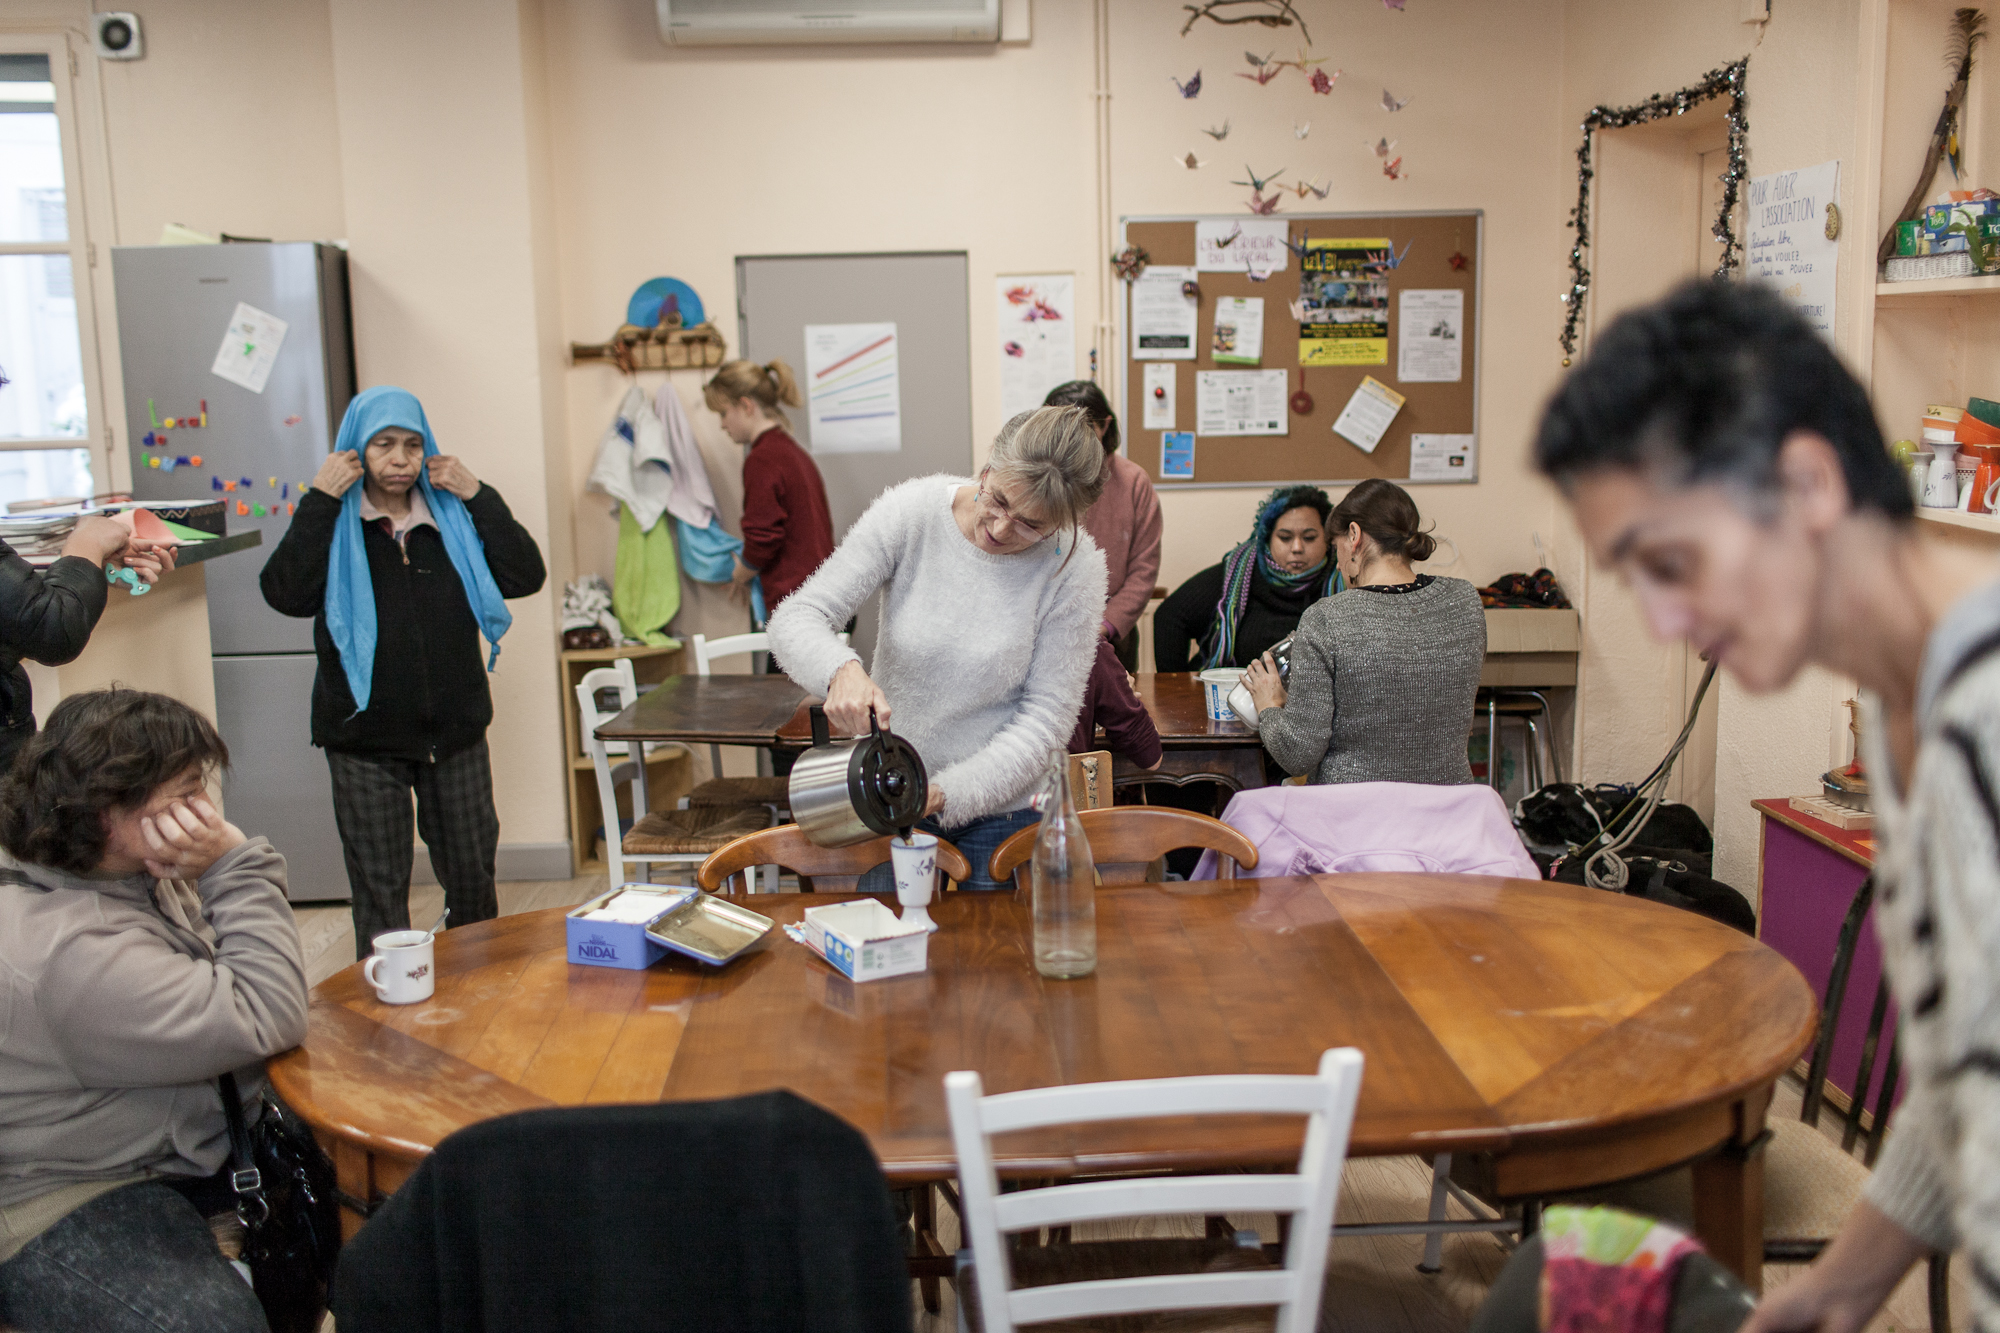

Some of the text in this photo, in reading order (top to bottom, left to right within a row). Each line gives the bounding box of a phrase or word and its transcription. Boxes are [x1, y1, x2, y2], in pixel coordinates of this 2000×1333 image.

[1751, 172, 1798, 206] POUR AIDER
[1761, 196, 1816, 228] L'ASSOCIATION
[578, 944, 620, 960] NIDAL
